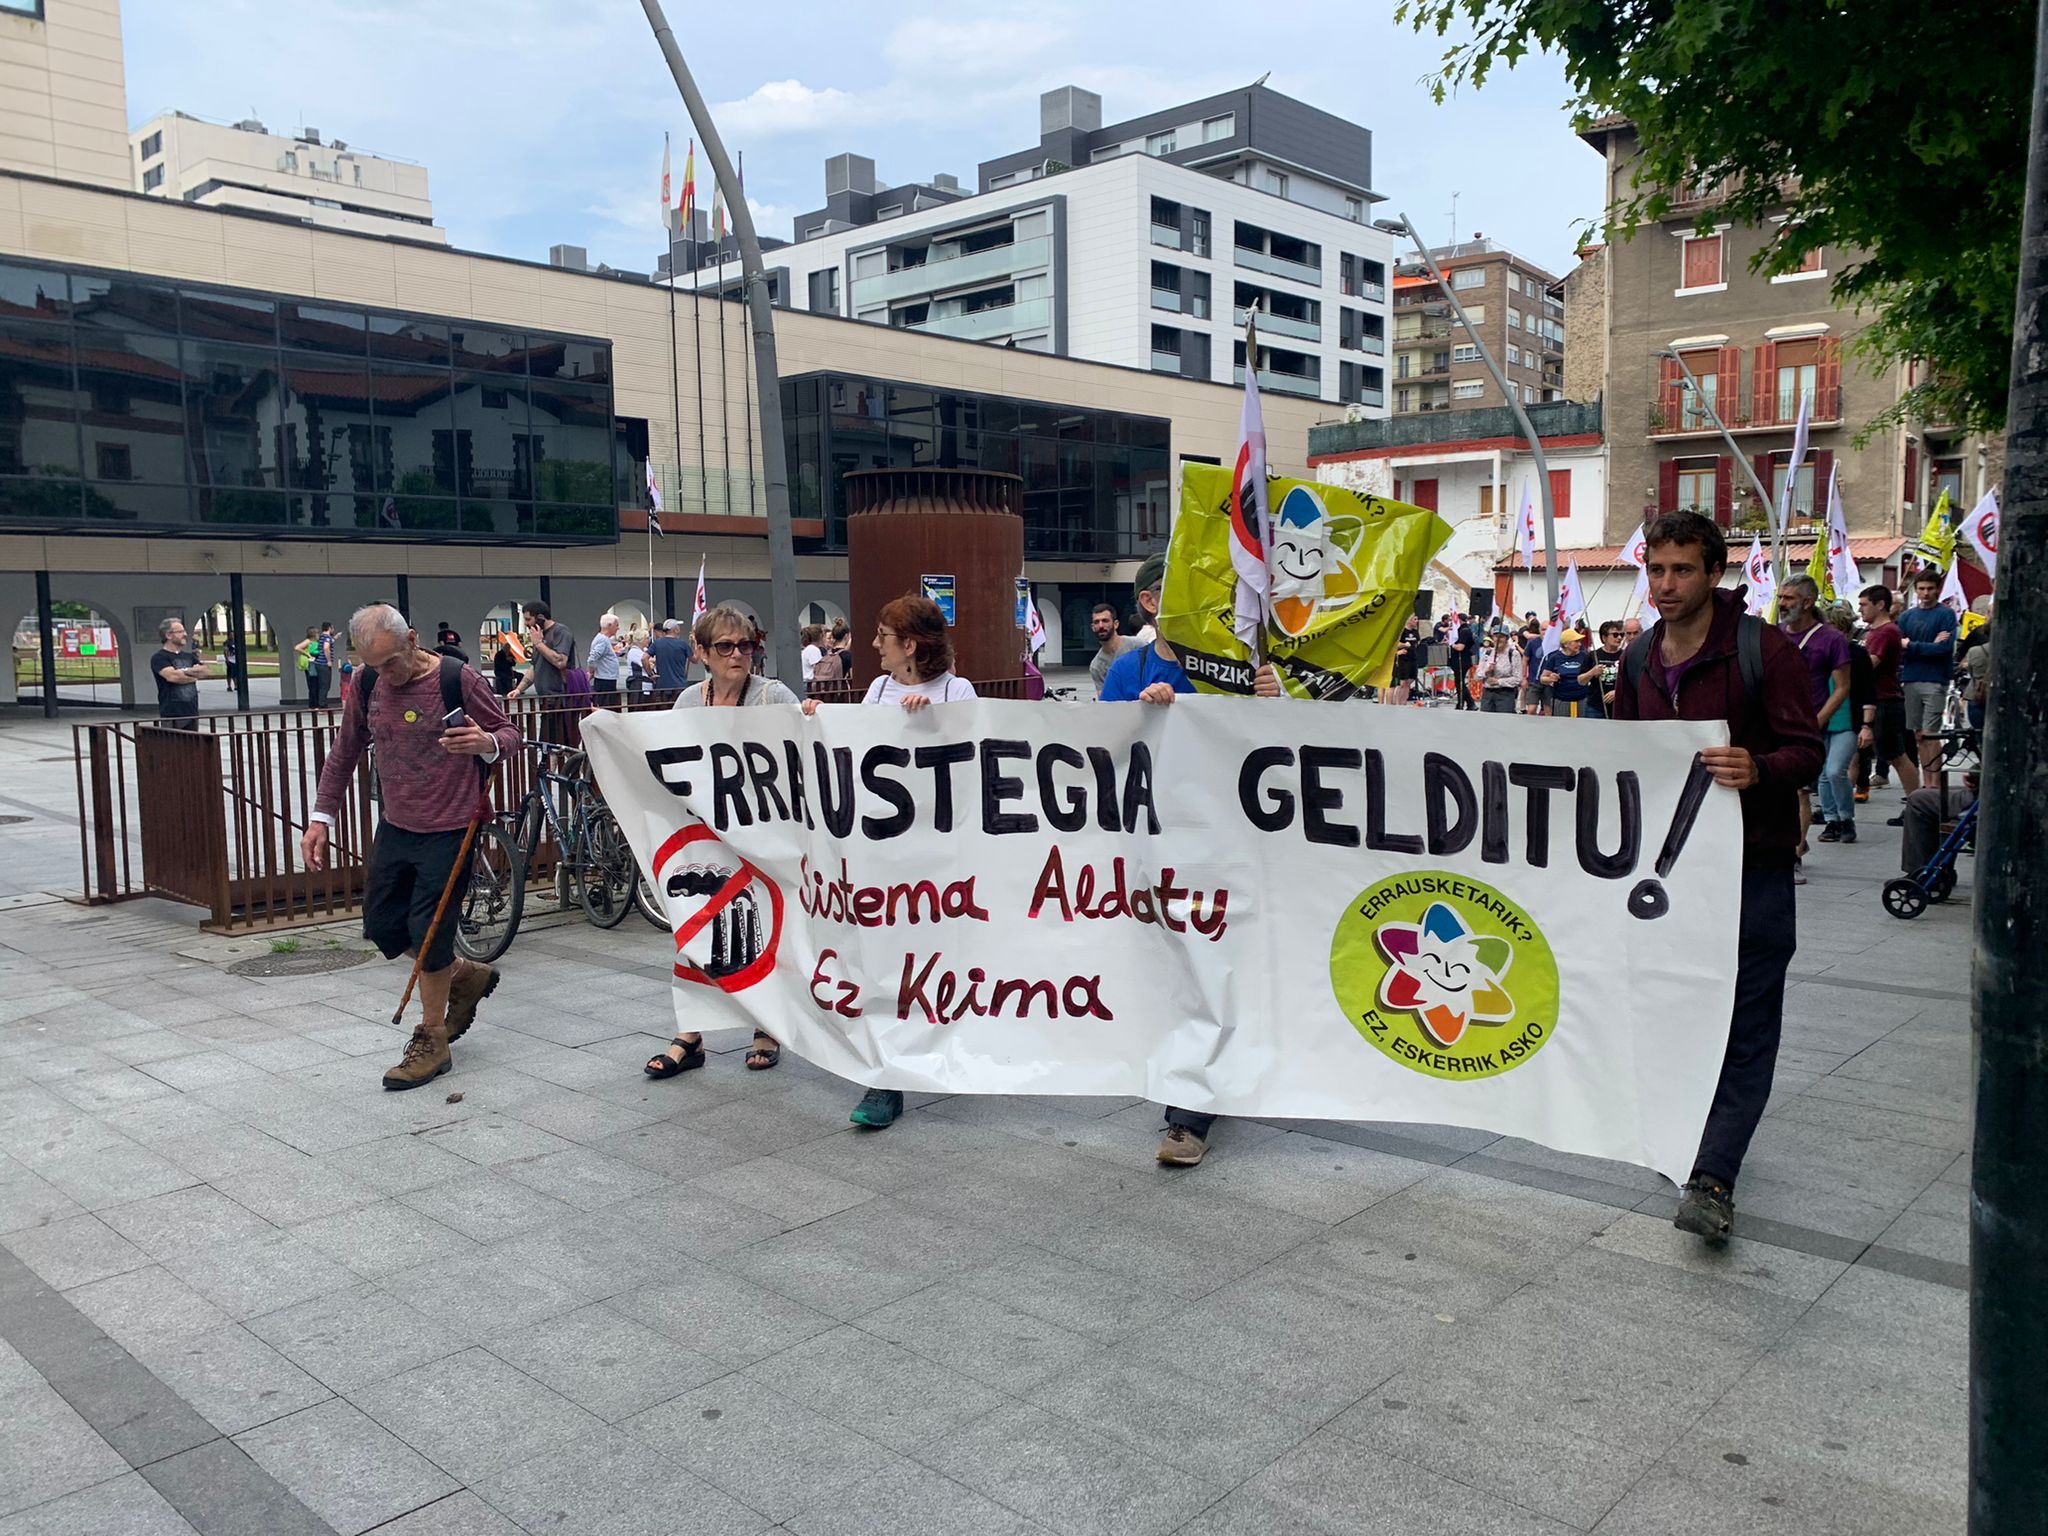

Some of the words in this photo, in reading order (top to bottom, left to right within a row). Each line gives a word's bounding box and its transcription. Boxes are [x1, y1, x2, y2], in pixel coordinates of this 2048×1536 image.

[645, 739, 1161, 841] ERRAUSTEGIA
[1239, 745, 1714, 921] GELDITU!
[799, 852, 990, 928] Sistema
[1028, 845, 1228, 942] Aldatu,
[1359, 878, 1533, 942] ERRAUSKETARIK?
[811, 949, 862, 1018] Ez
[897, 951, 1114, 1025] Klima
[1362, 1009, 1388, 1043] EZ,
[1391, 1036, 1498, 1073] ESKERRIK
[1500, 1022, 1543, 1064] ASKO
